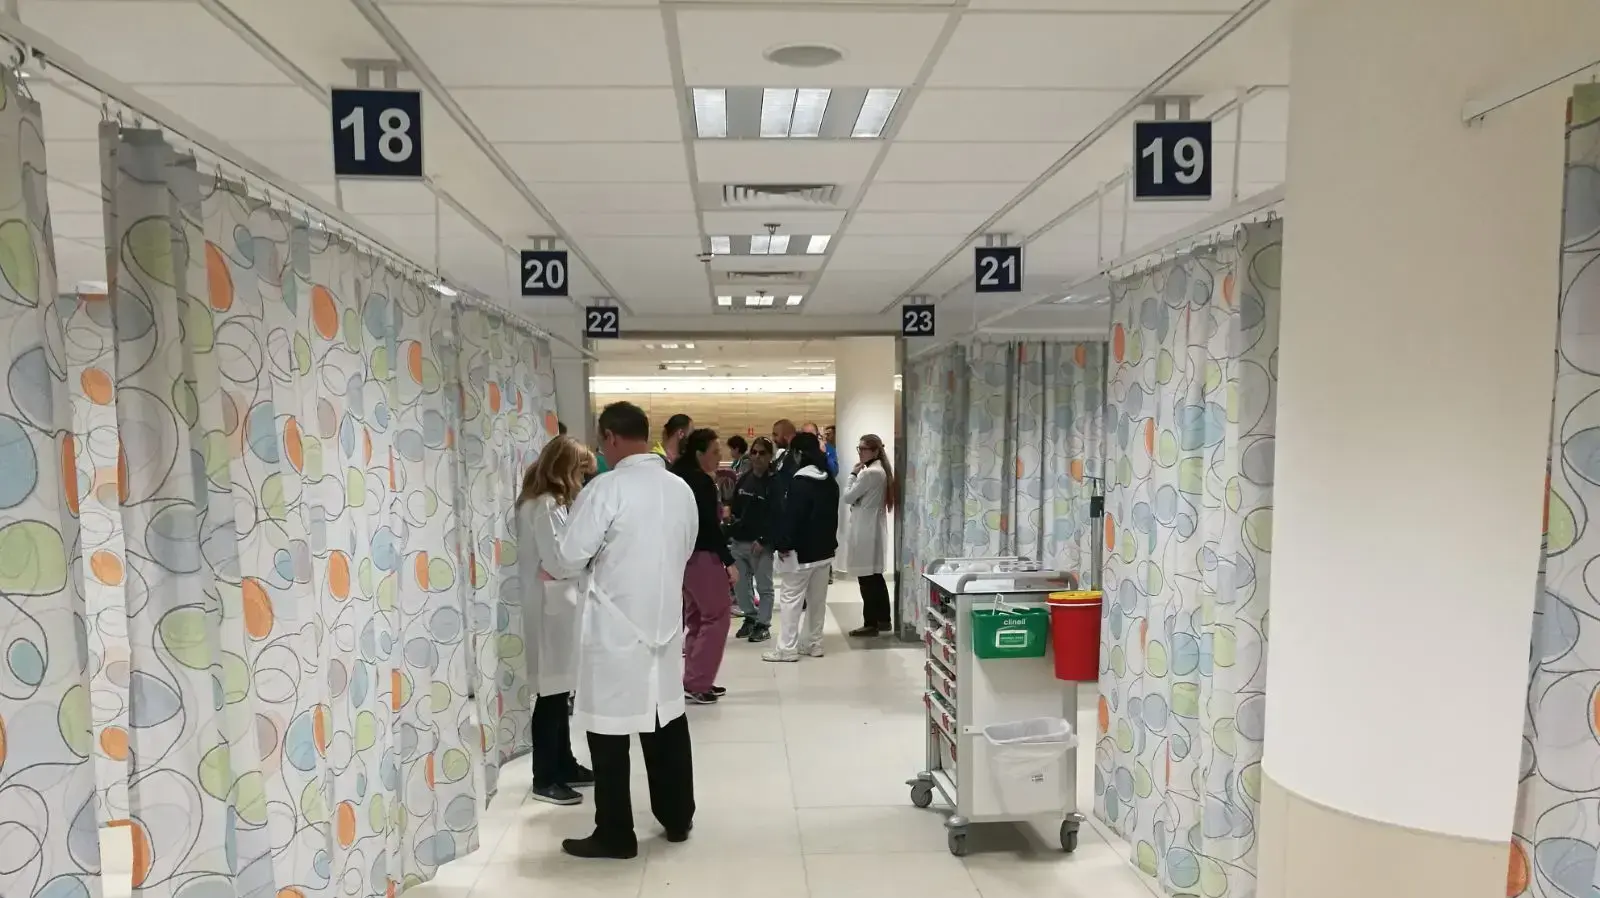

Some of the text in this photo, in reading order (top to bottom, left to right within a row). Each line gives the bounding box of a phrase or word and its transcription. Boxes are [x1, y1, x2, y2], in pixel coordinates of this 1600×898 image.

[340, 107, 413, 162] 18
[1142, 137, 1204, 184] 19
[524, 259, 565, 289] 20
[980, 255, 1016, 285] 21
[588, 312, 617, 332] 22
[905, 311, 932, 332] 23
